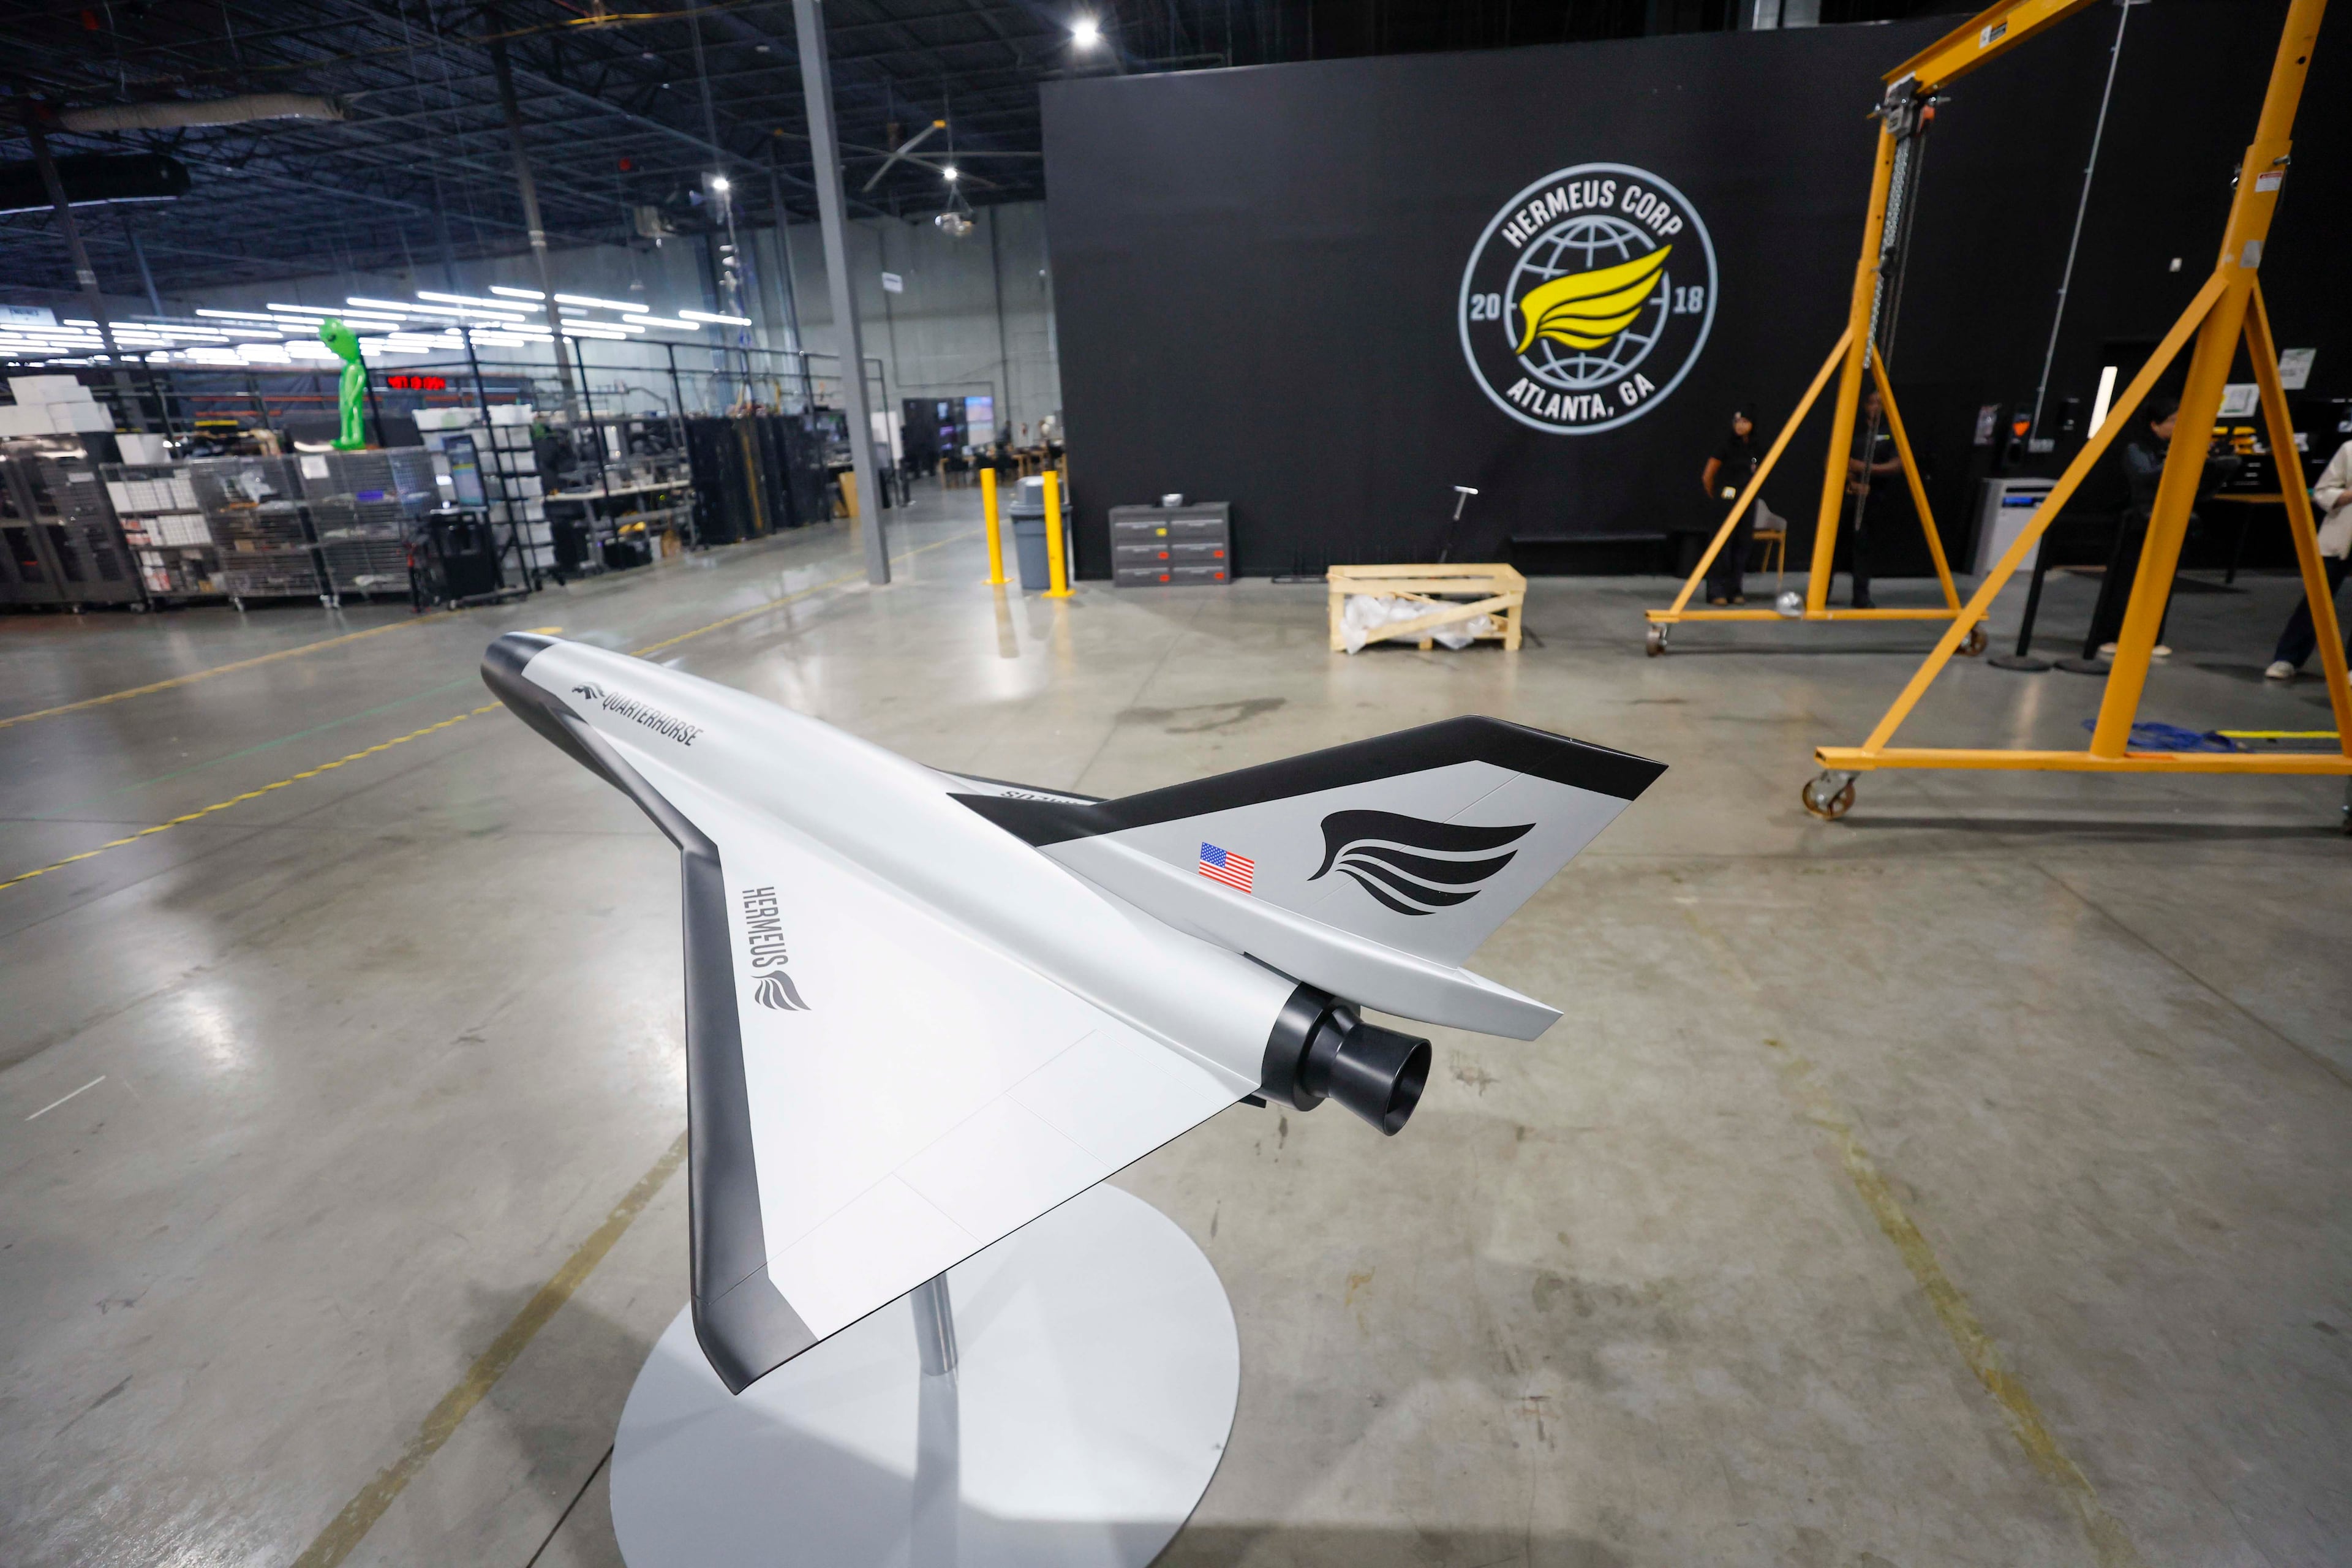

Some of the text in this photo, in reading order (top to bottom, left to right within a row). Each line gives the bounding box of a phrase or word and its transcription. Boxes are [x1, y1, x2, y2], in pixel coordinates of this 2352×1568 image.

[1502, 179, 1683, 248] HERMEUS CORP
[1471, 293, 1501, 320] 20
[1673, 286, 1705, 314] 18
[1507, 373, 1656, 421] ATLANTA, GA
[602, 693, 704, 747] QUARTERHORSE
[742, 886, 789, 968] HERMEUS
